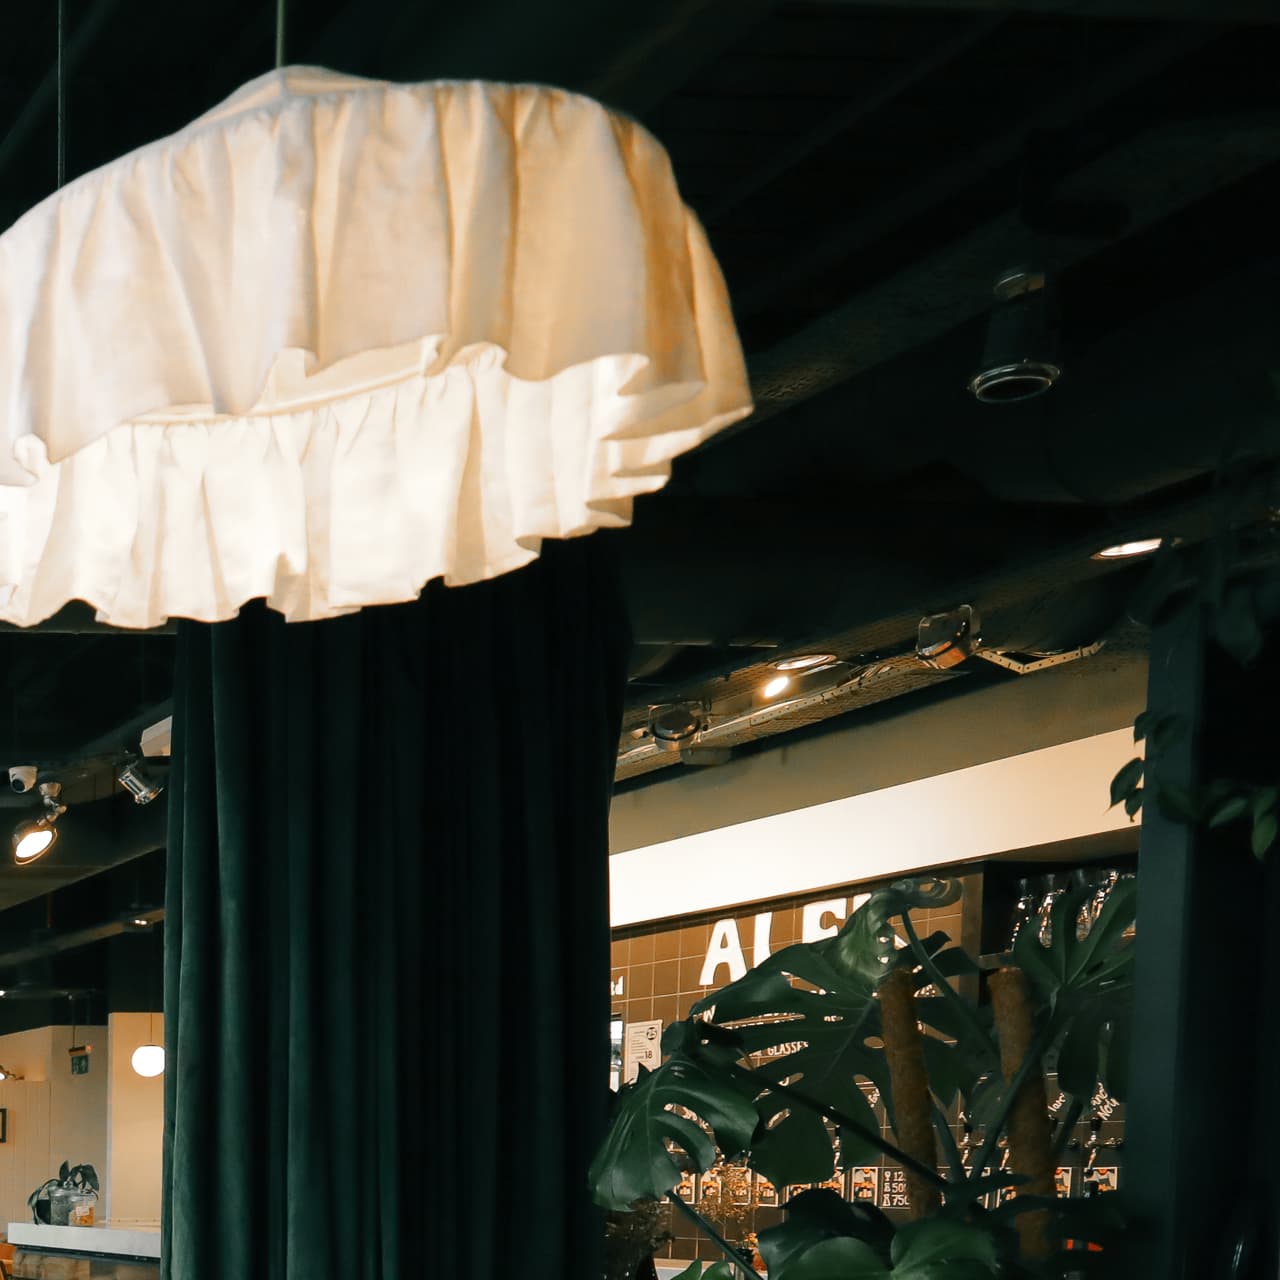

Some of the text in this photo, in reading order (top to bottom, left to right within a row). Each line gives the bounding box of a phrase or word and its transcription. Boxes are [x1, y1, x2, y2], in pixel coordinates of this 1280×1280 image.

[699, 893, 872, 986] ALF
[893, 1171, 906, 1182] 12
[892, 1182, 907, 1193] 50
